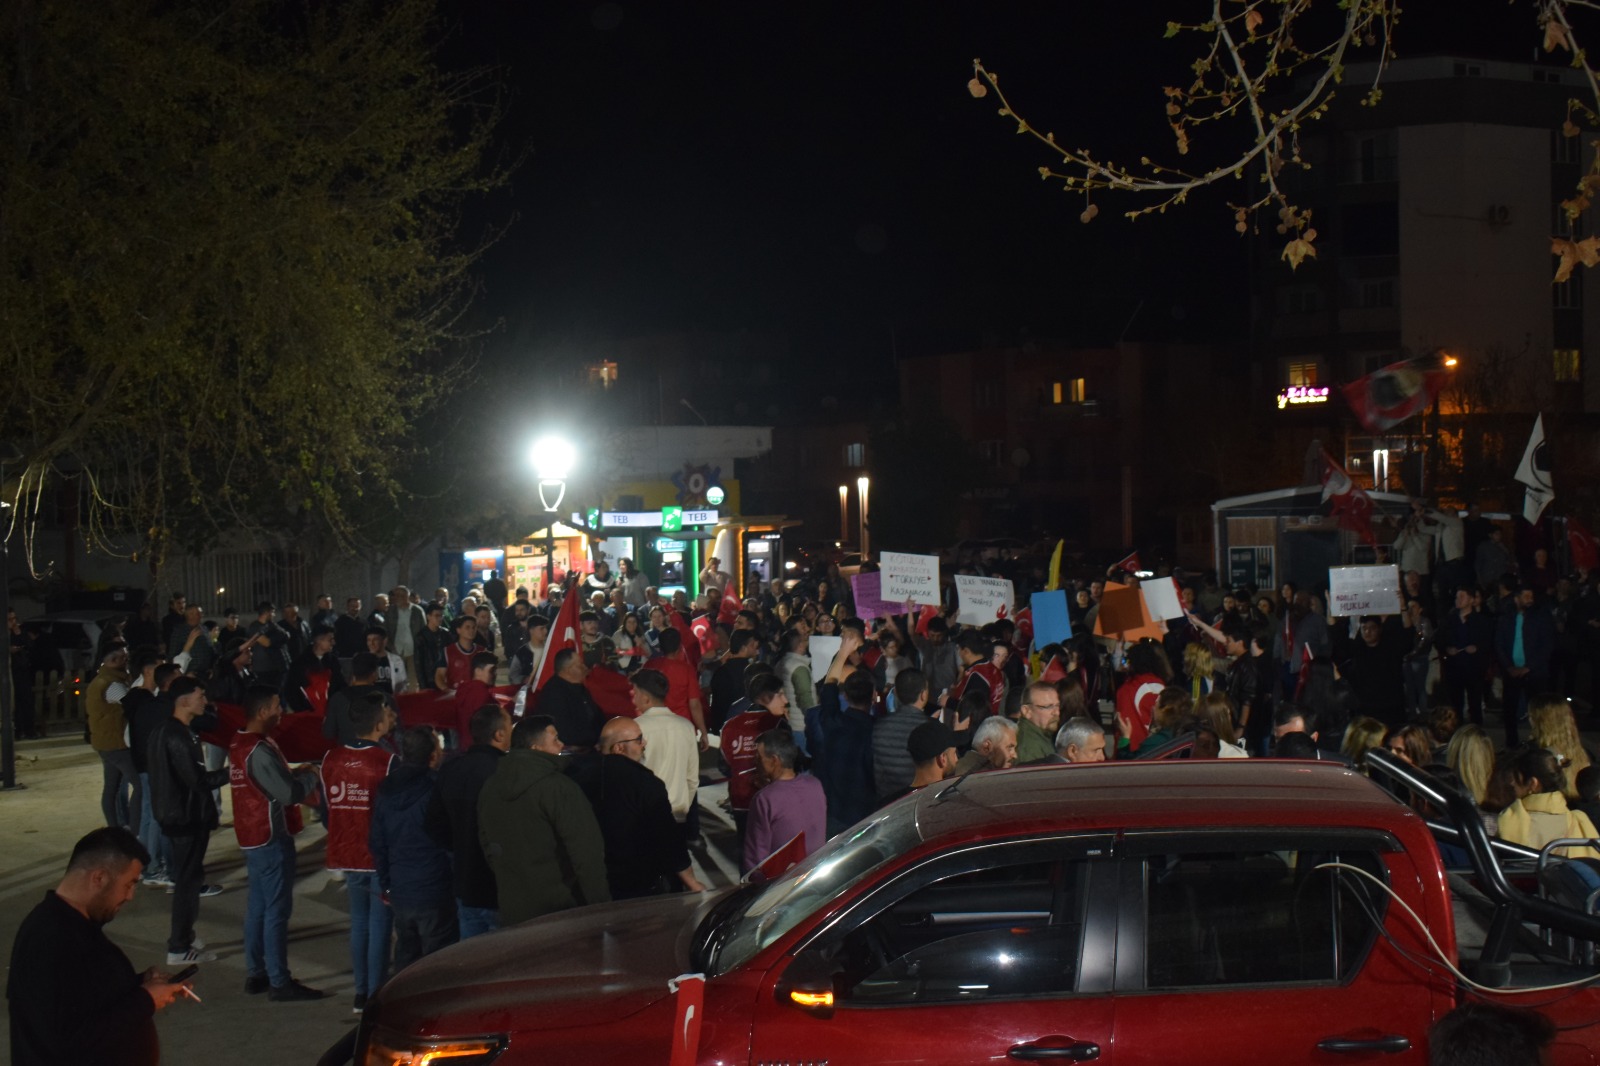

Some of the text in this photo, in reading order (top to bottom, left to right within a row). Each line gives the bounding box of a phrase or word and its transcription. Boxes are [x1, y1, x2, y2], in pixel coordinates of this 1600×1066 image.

[612, 515, 628, 524] TEB
[688, 512, 708, 522] TEB
[1339, 601, 1370, 611] HUKUK
